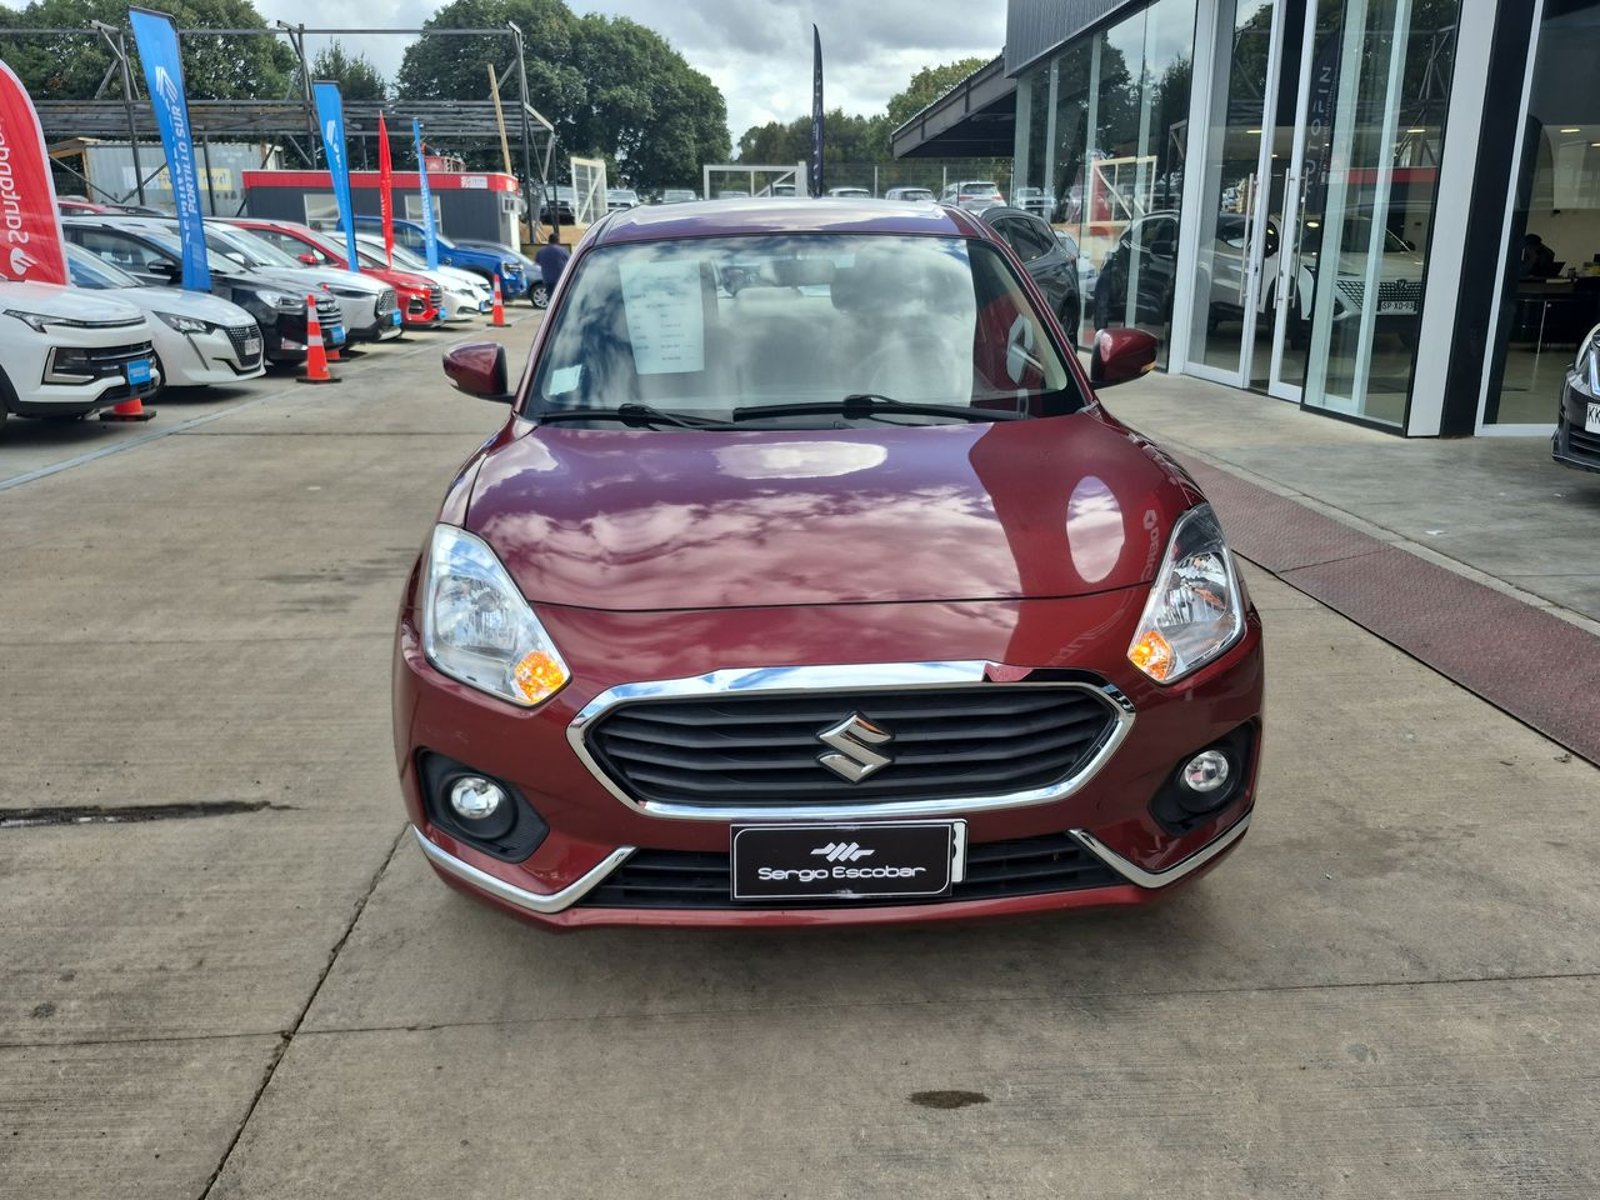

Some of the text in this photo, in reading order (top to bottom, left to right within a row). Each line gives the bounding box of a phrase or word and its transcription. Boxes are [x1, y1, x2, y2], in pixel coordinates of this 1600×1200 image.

[171, 106, 186, 138] SUR
[179, 143, 198, 214] PORTILLO
[758, 866, 926, 882] Sergio Escobar
